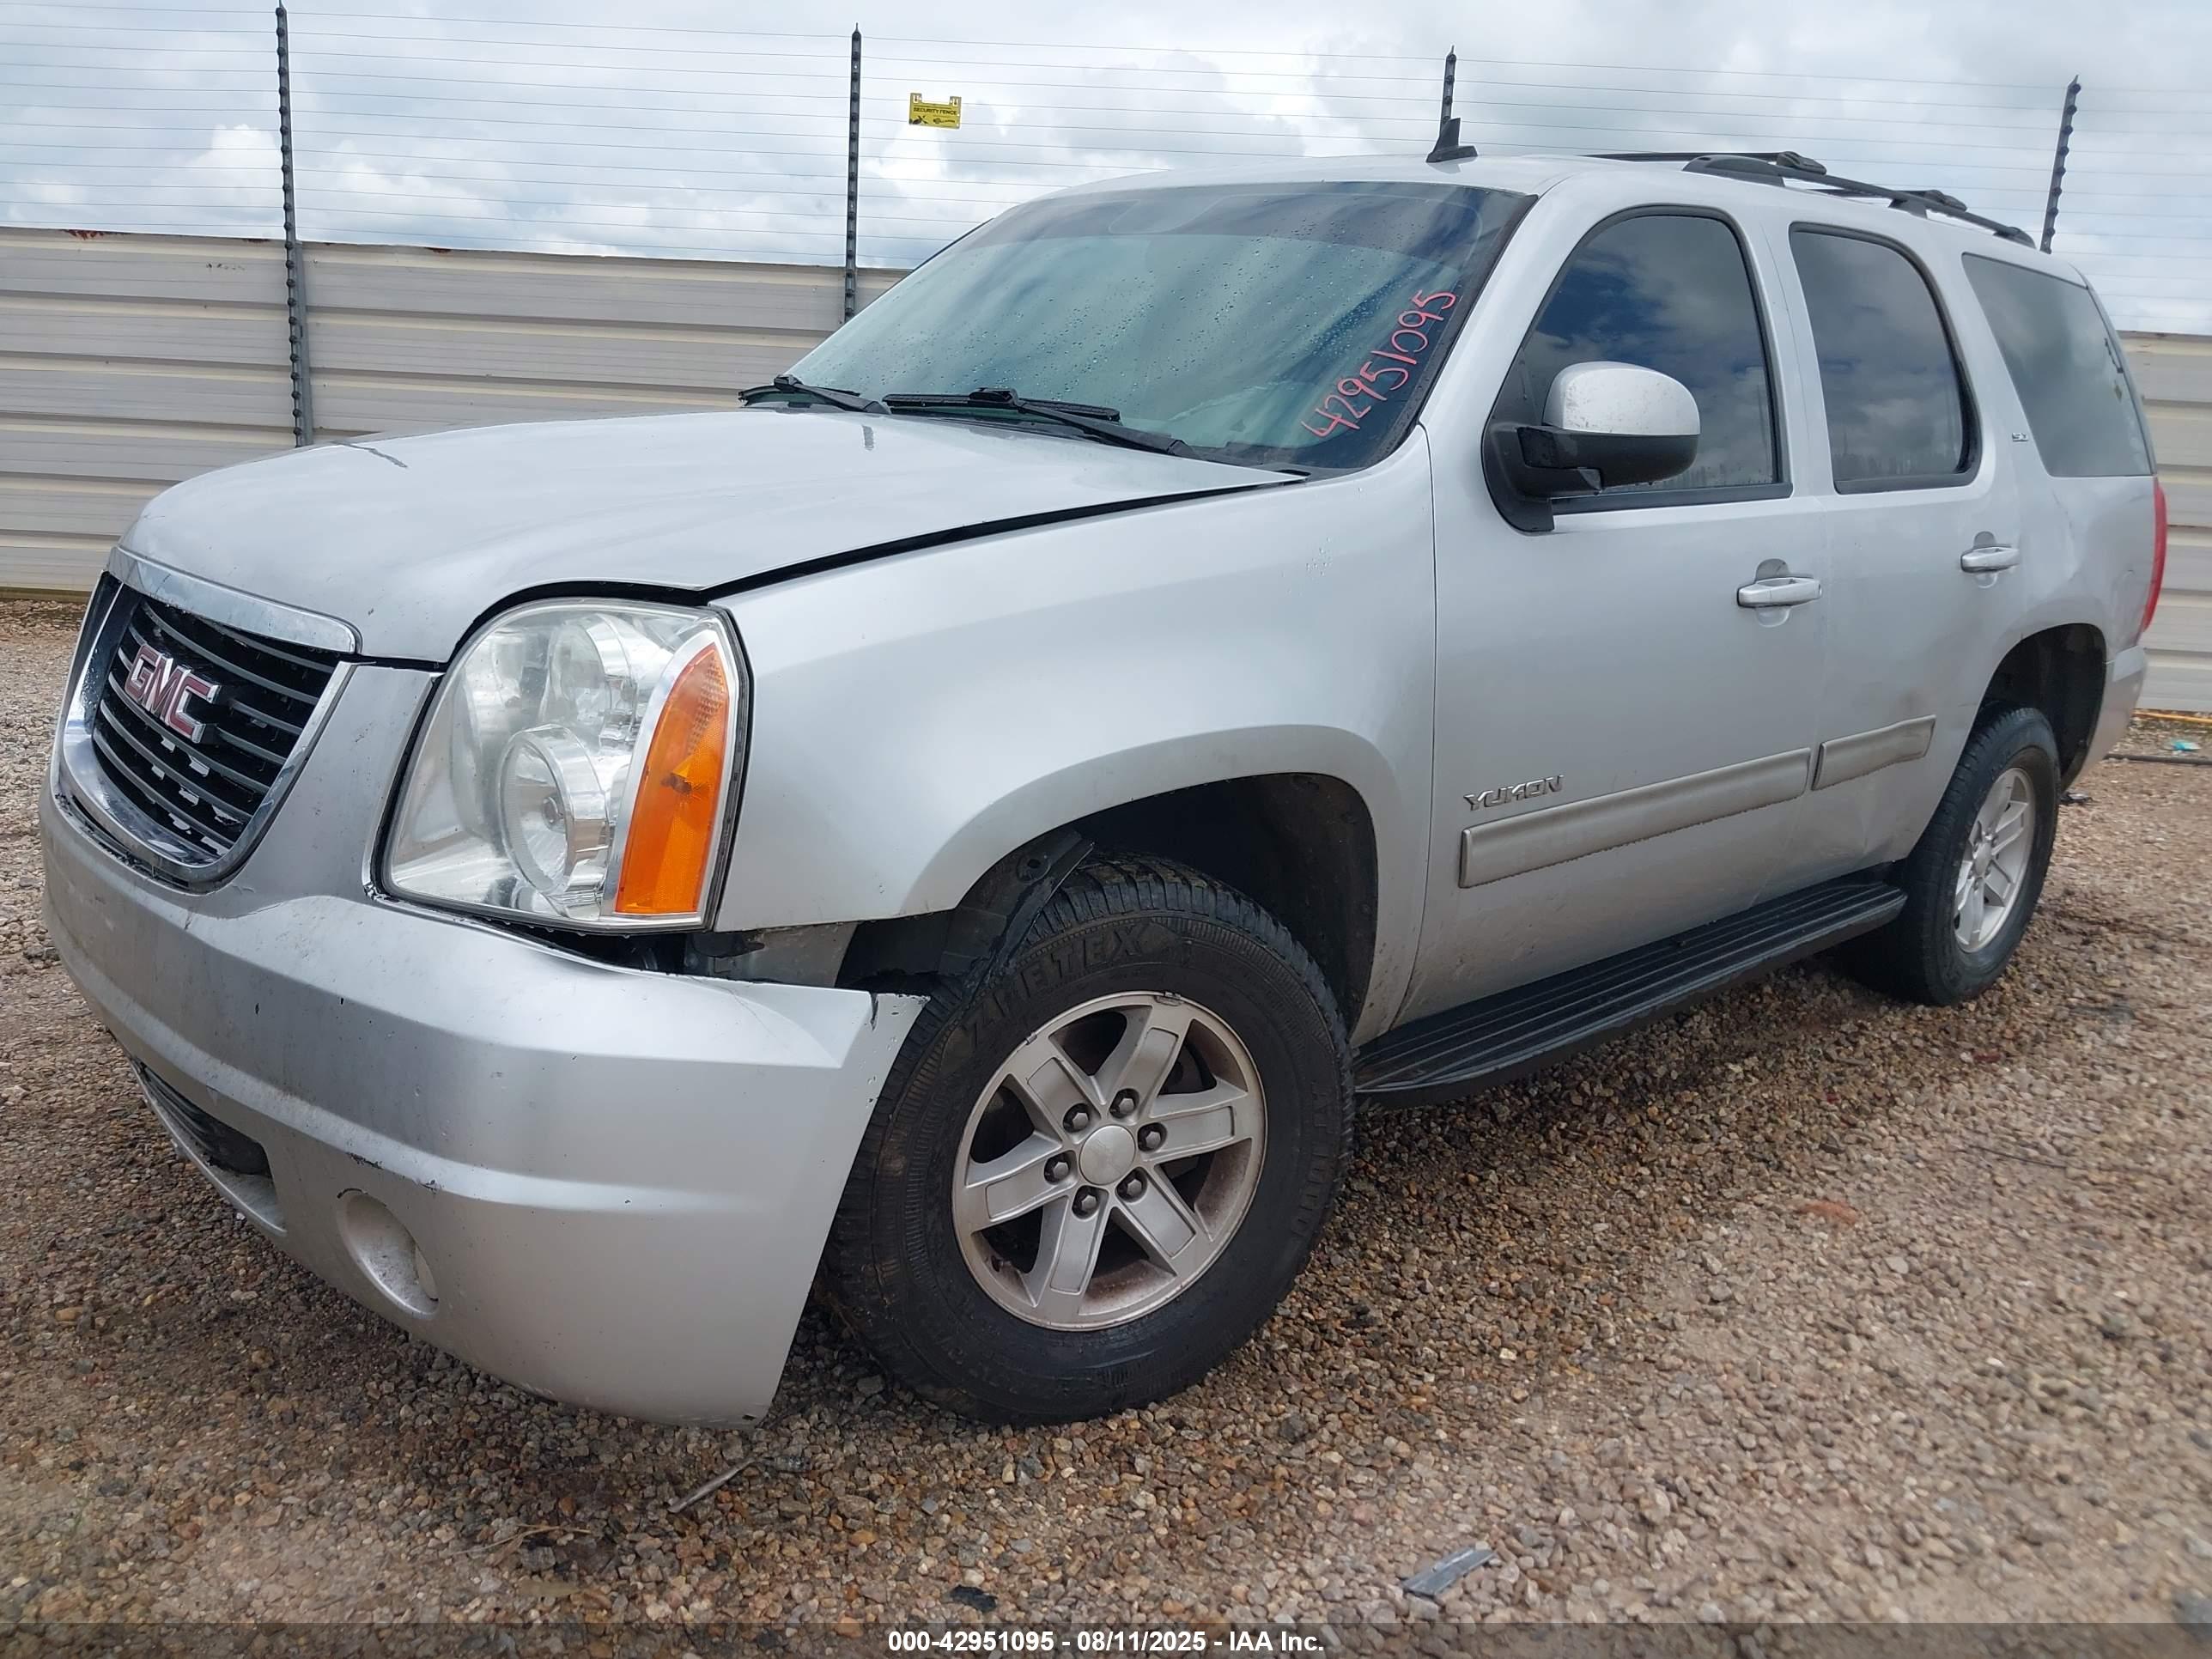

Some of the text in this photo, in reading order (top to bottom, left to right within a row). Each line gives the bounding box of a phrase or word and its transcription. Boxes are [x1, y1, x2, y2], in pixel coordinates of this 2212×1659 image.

[1300, 289, 1456, 437] 42951095
[125, 644, 221, 744] GMC
[1462, 775, 1565, 811] YUKON
